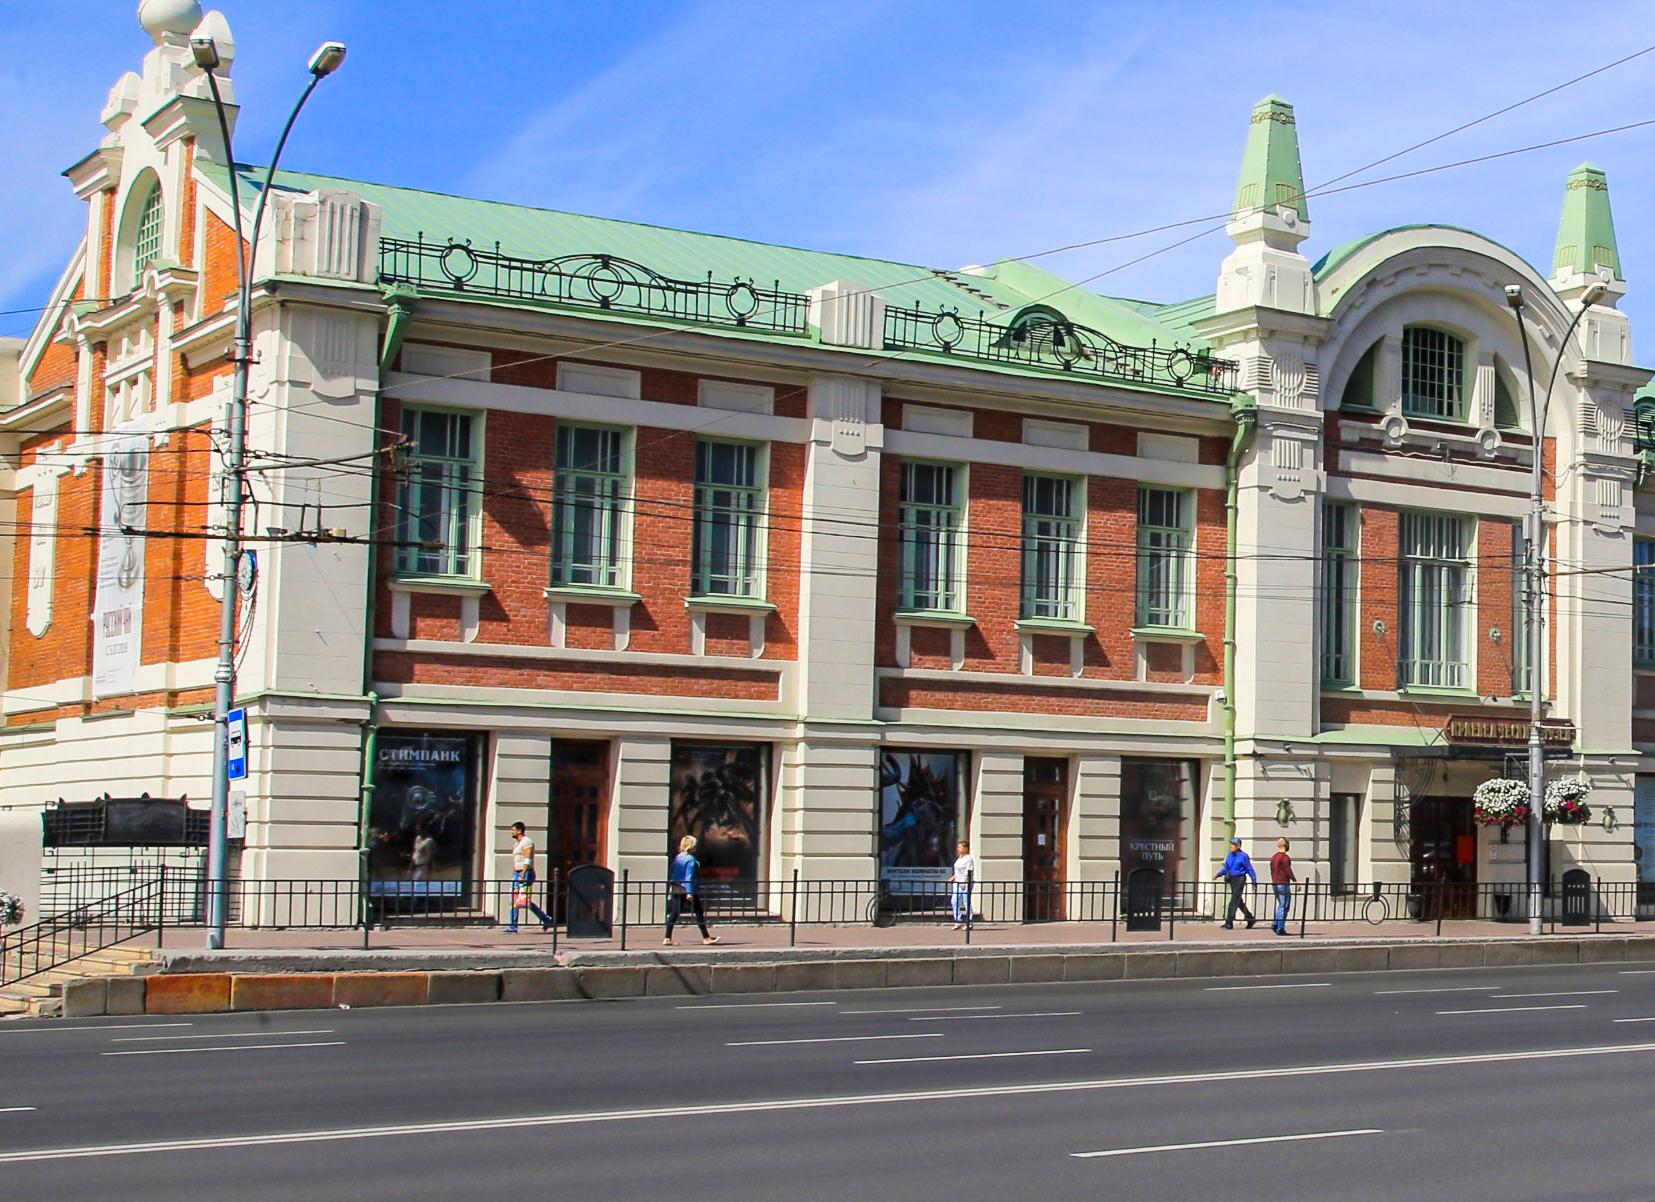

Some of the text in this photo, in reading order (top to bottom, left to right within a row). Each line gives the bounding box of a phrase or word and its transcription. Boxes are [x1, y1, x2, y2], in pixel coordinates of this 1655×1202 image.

[1451, 721, 1532, 738] КРАЕВЕДЧЕСКИ
[380, 749, 460, 761] СТИМПАНК
[1129, 841, 1175, 851] КРЕСТНЫЙ
[1141, 852, 1164, 860] ПУТЬ
